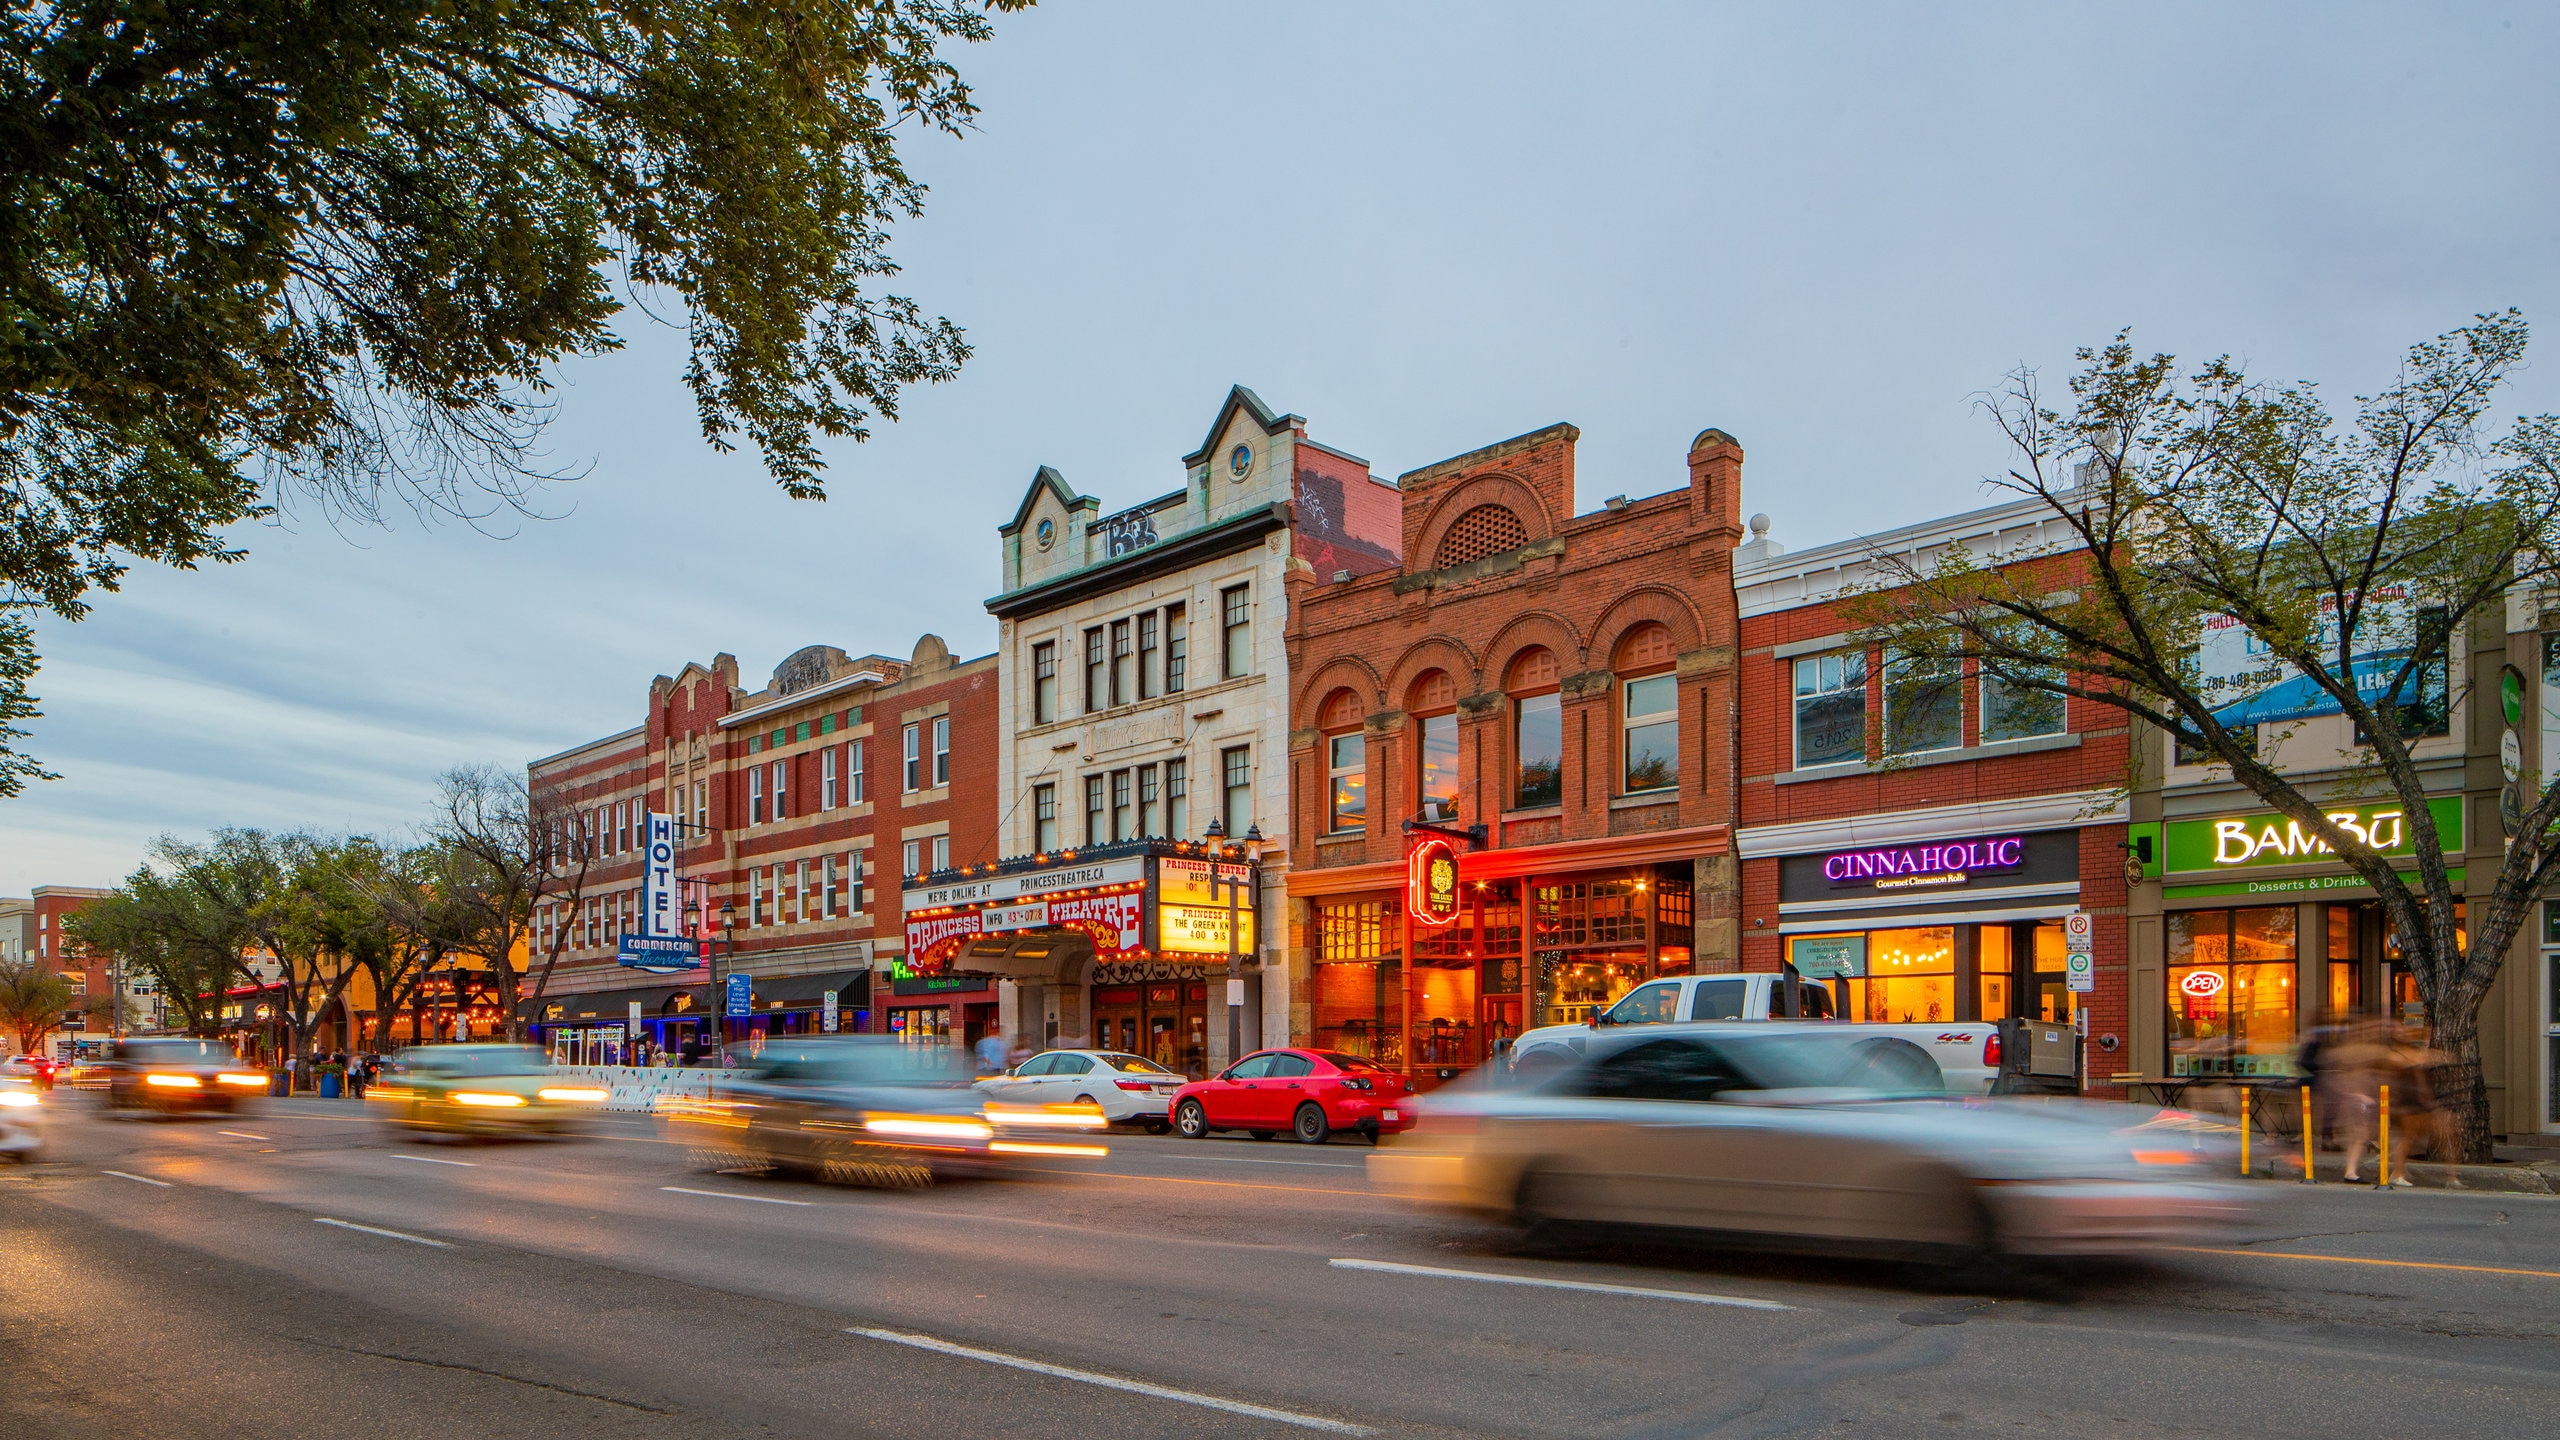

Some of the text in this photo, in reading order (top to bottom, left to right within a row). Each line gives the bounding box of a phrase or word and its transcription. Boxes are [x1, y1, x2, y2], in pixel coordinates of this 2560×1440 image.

[2207, 615, 2235, 630] FULLY
[1166, 860, 1207, 871] PRINCESS
[1825, 839, 2021, 880] CINNAHOLIC
[653, 820, 671, 933] HOTEL
[1876, 873, 1965, 889] Gourmet Cinnamon Rolls
[2249, 876, 2366, 893] Desserts & Drinks
[928, 868, 1104, 903] WE'RE ONLINE AT PRINCESSTHEATRE.CA
[986, 913, 1003, 926] INFO
[1051, 893, 1140, 950] THEATRE
[1183, 909, 1223, 920] PRINCESS
[1175, 919, 1188, 928] THE
[1193, 920, 1216, 930] GREEN
[907, 915, 980, 968] PRINCESS
[638, 950, 686, 966] Licensed
[951, 979, 960, 987] Bar
[2186, 977, 2219, 990] OPEN
